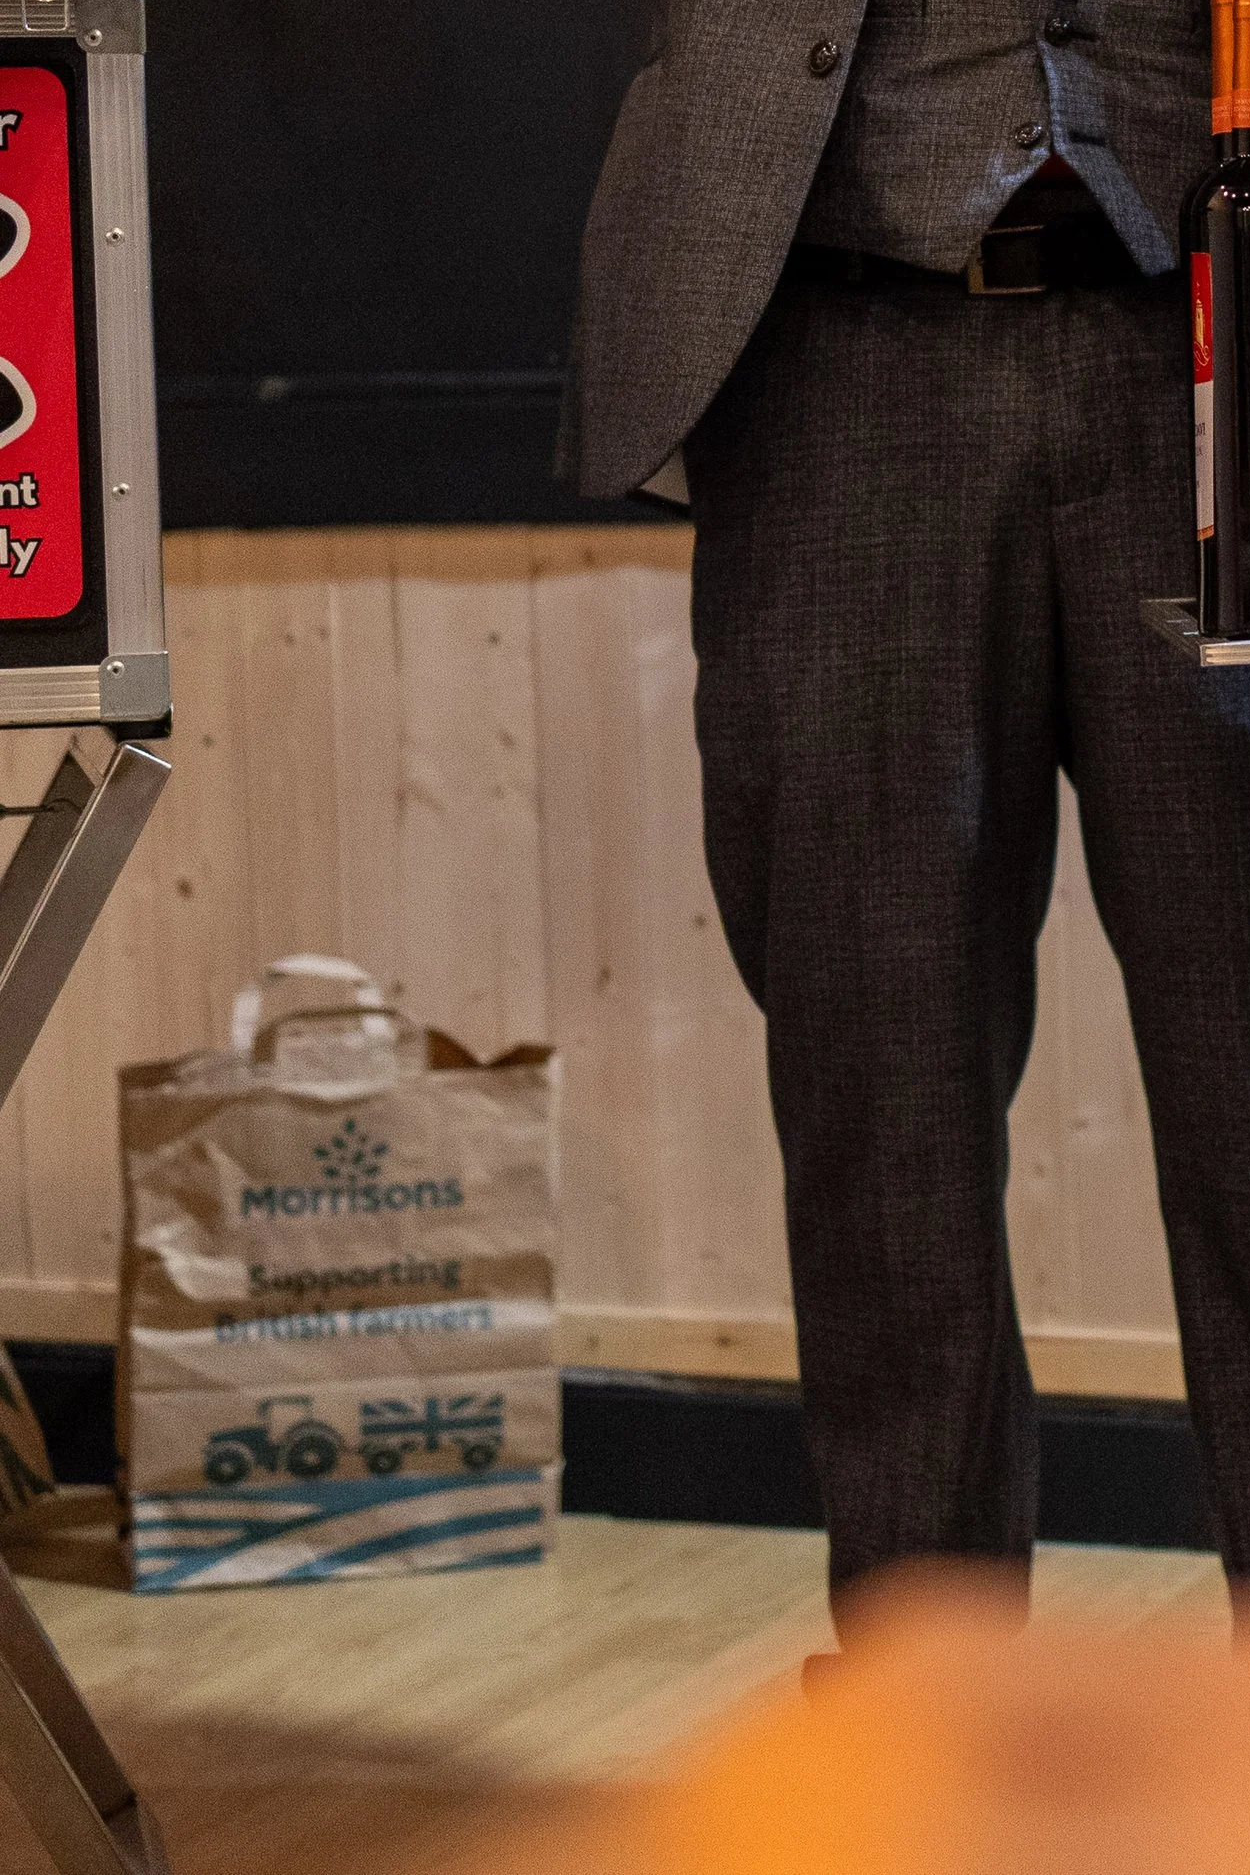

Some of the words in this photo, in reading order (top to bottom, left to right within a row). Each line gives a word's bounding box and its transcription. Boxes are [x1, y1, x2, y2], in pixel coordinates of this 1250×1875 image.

[241, 1177, 464, 1219] Morrisons
[248, 1259, 461, 1299] Supporting
[215, 1305, 338, 1343] British
